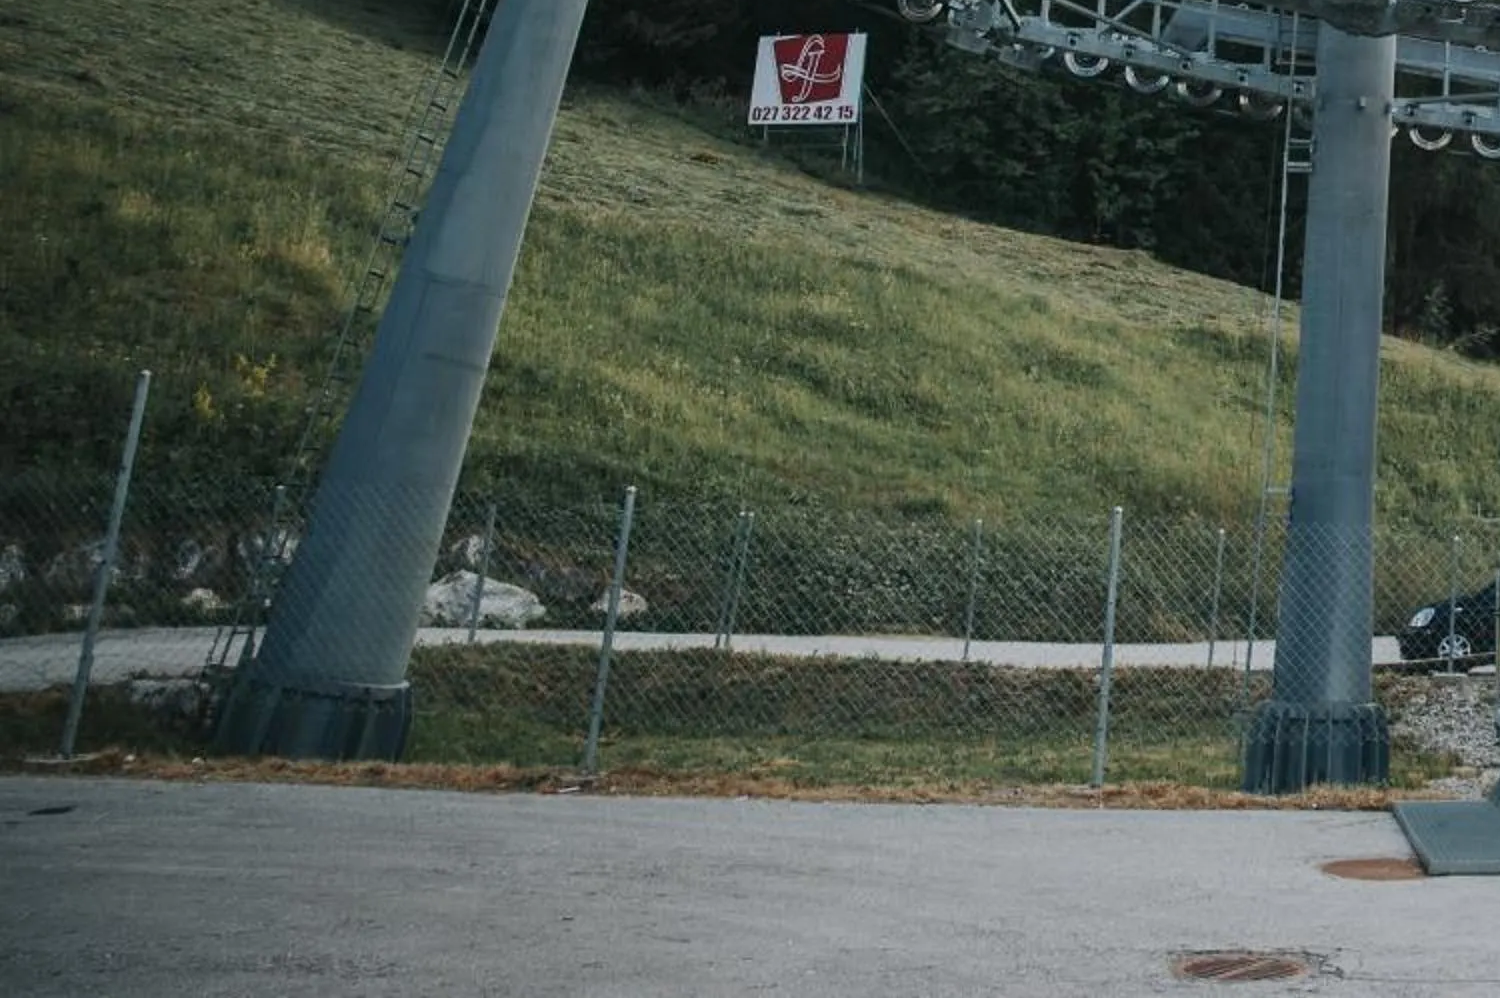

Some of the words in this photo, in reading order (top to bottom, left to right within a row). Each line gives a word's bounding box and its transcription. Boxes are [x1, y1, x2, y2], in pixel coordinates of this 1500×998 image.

[752, 106, 778, 121] 027
[782, 105, 810, 121] 322
[813, 105, 832, 121] 42
[837, 105, 853, 120] 15
